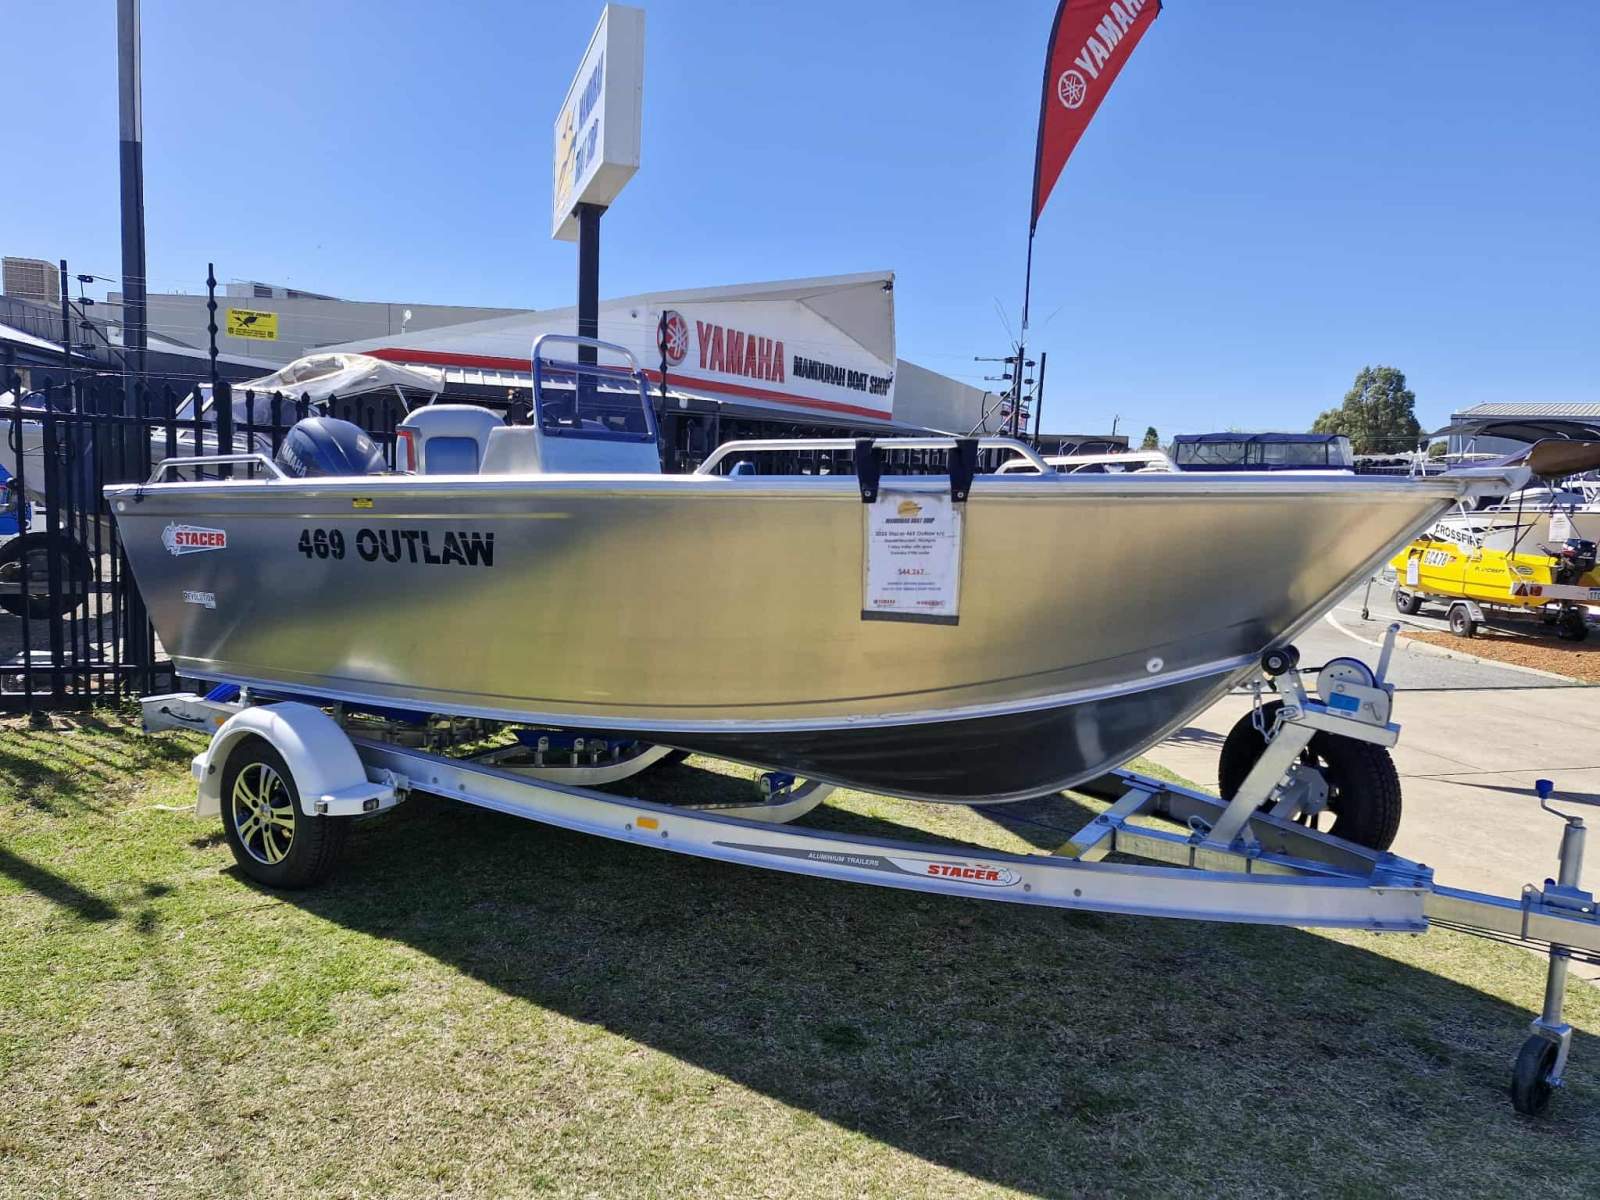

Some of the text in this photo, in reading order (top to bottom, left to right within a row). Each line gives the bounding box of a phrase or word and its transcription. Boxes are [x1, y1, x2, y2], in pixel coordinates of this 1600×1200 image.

[1074, 0, 1146, 79] YAMAH
[697, 321, 785, 384] YAMAHA
[793, 355, 892, 396] MANDURAH BOAT SHOP
[176, 532, 225, 547] STACER
[298, 528, 495, 567] 469 OUTLAW
[807, 852, 880, 867] ALUMINIUM TRAILERS
[928, 864, 999, 881] STACER
